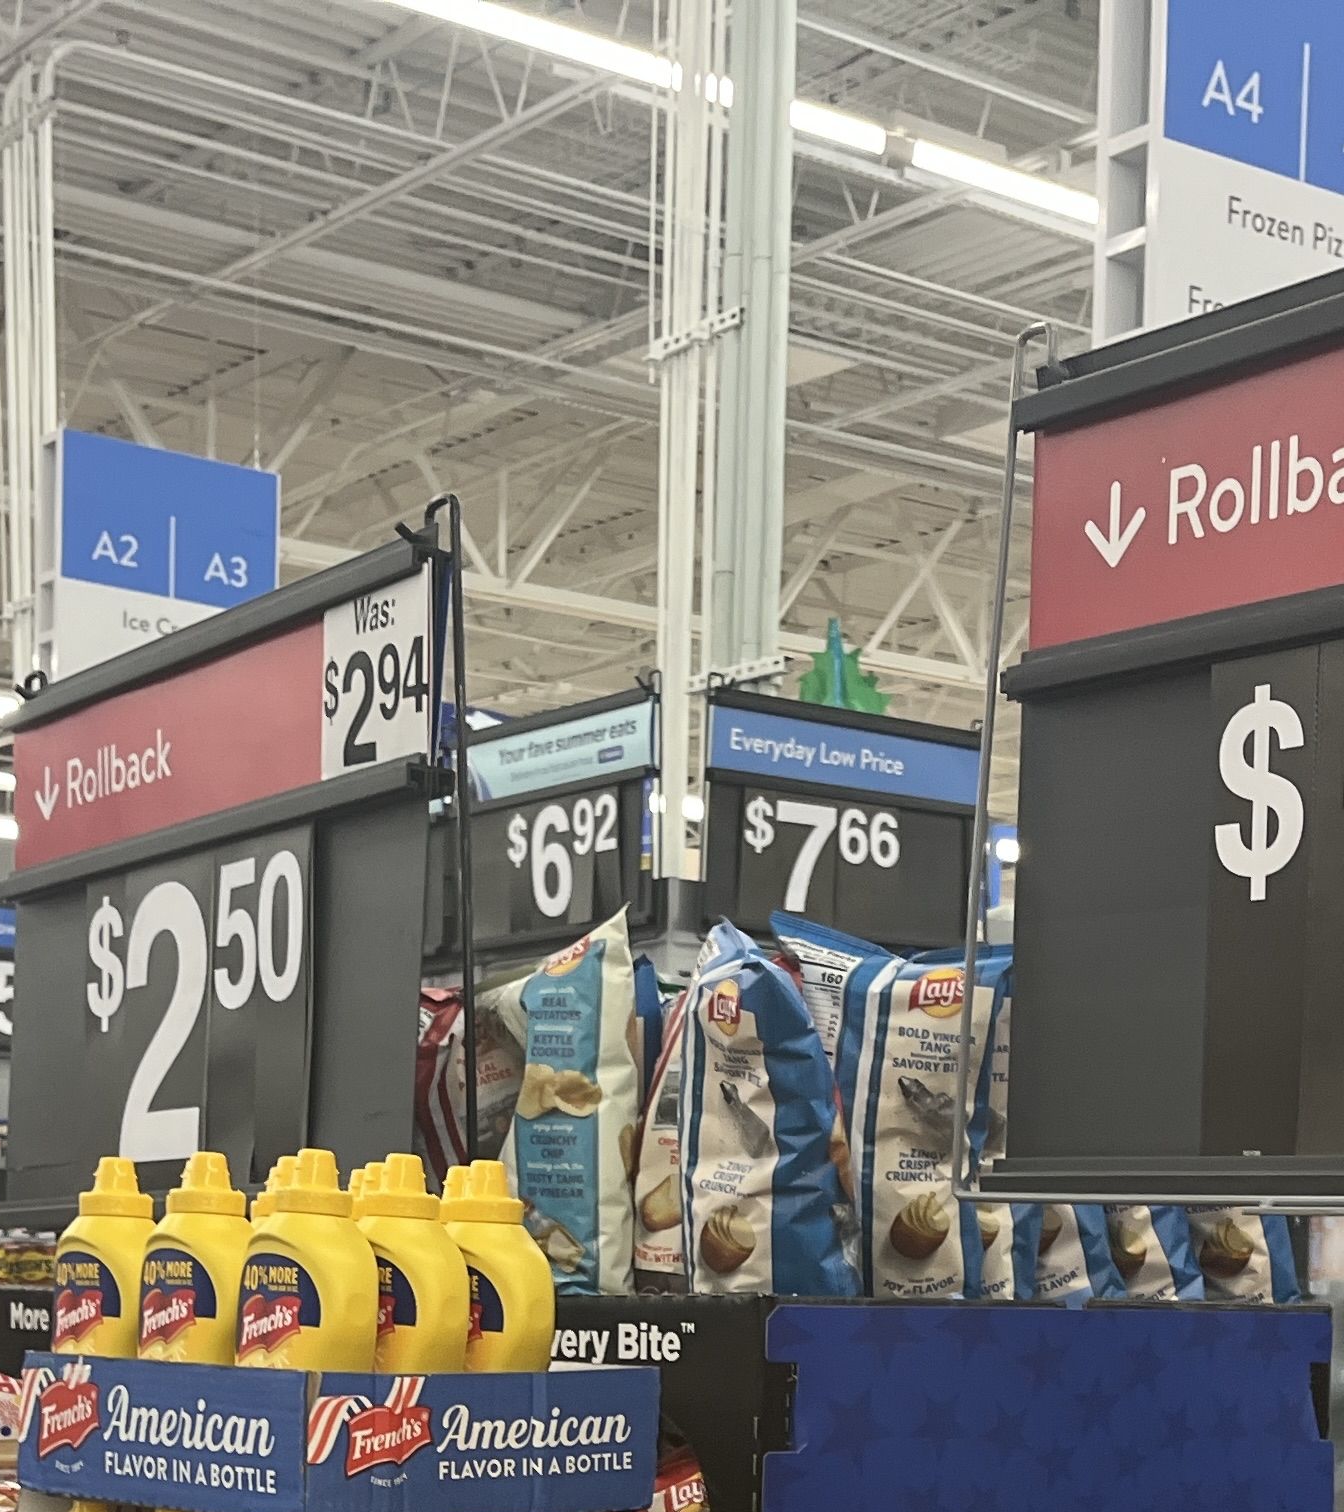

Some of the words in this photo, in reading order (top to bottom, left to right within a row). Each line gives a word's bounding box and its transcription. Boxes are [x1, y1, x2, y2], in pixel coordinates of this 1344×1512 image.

[1201, 59, 1265, 124] A4
[1227, 196, 1305, 248] Frozen
[93, 531, 139, 568] A2
[204, 553, 249, 589] A3
[122, 610, 149, 633] Ice
[354, 597, 396, 636] Was:
[498, 747, 525, 767] Your
[529, 738, 555, 760] fave
[557, 729, 607, 752] summer
[609, 717, 638, 739] eats
[729, 726, 817, 768] Everyday
[820, 741, 857, 766] Low
[859, 748, 905, 777] Price
[66, 729, 172, 810] Rollback
[820, 972, 843, 985] 160
[918, 976, 966, 1008] Lay's
[898, 1026, 930, 1039] BOLD
[933, 1031, 976, 1046] VINEGR
[919, 1041, 952, 1055] TANG
[892, 1057, 940, 1073] SAVORY
[898, 1159, 939, 1172] CRISPY
[910, 1148, 947, 1161] ZINGY
[885, 1170, 933, 1184] CRUNCH
[243, 1264, 271, 1290] 40%
[271, 1265, 300, 1285] MORE
[9, 1301, 52, 1332] More
[242, 1300, 294, 1343] French's
[549, 1330, 610, 1366] very
[352, 1420, 423, 1458] French's
[436, 1404, 632, 1453] American
[437, 1458, 518, 1482] FLAVOR
[522, 1457, 543, 1477] IN
[545, 1455, 561, 1476] A
[565, 1451, 633, 1473] BOTTLE
